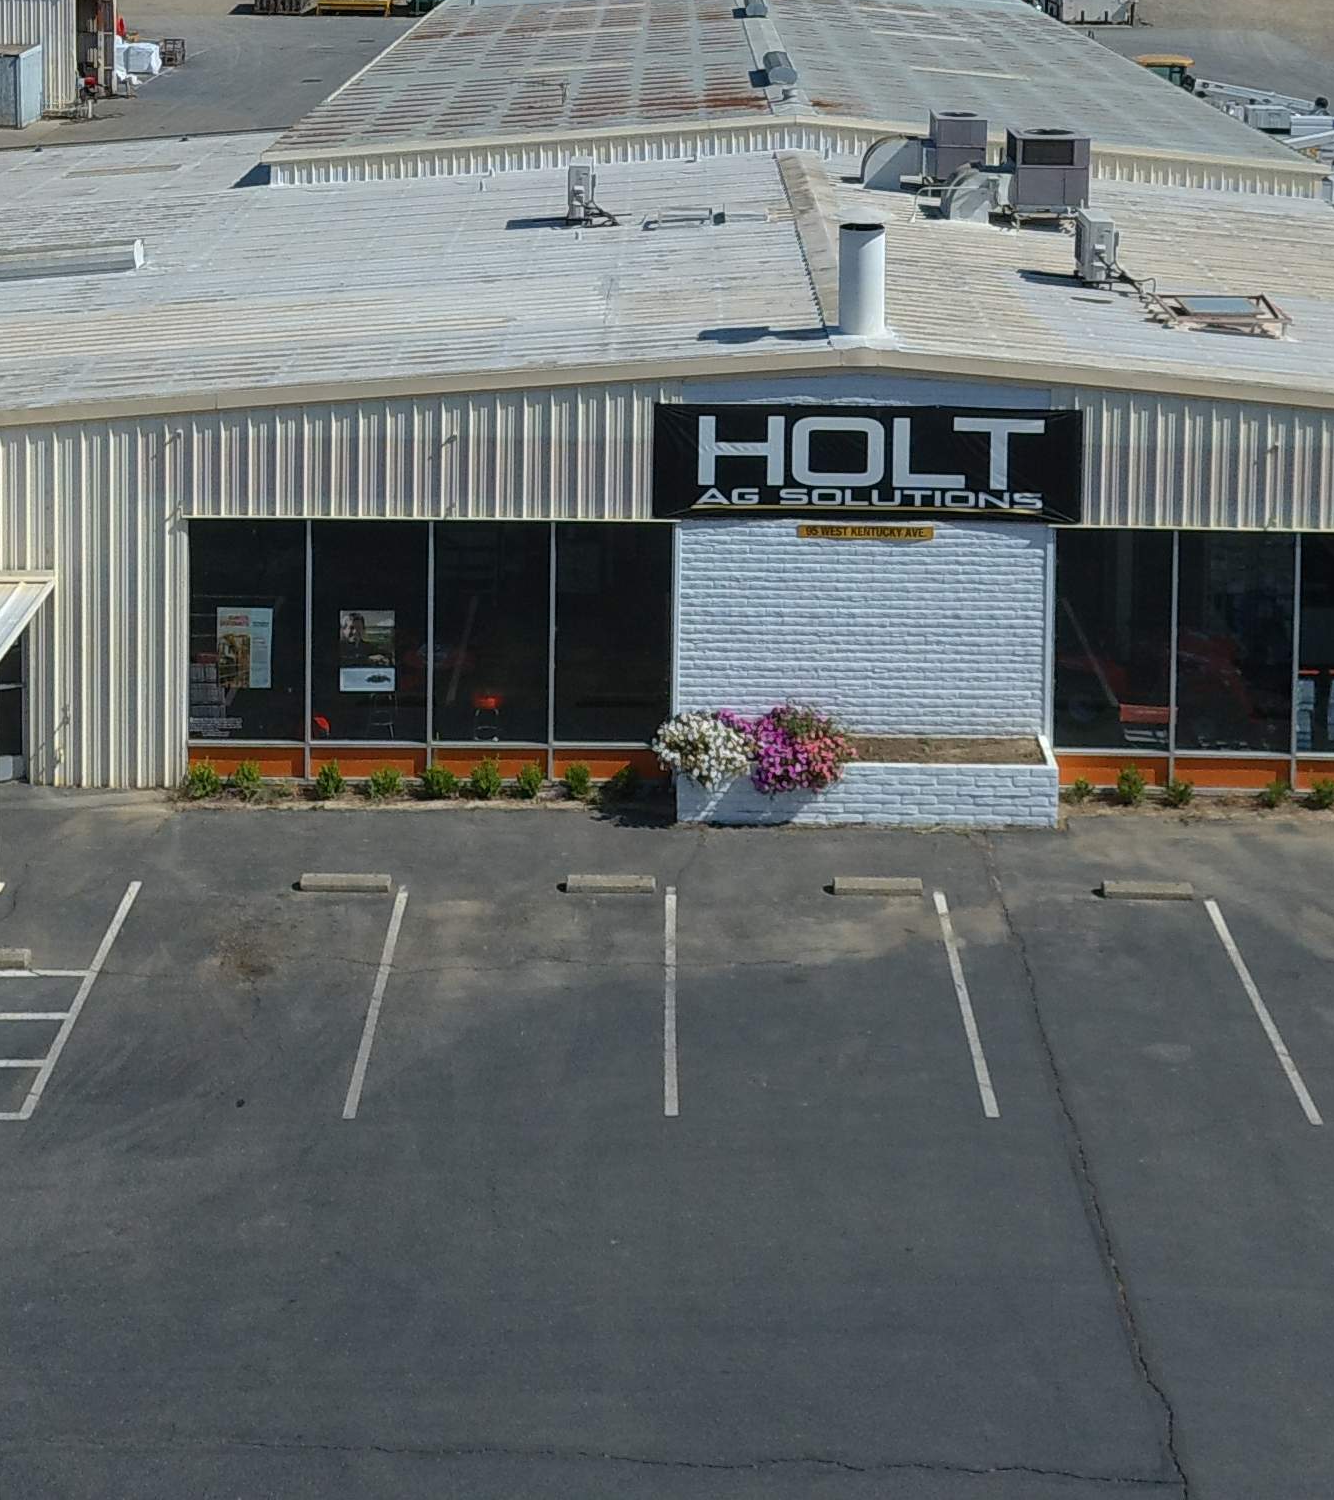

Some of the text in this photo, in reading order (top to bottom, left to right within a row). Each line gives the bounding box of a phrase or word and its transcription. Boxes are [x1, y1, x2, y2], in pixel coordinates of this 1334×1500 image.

[697, 415, 1046, 491] HOLT
[696, 488, 1044, 509] AG SOLUTIONS
[821, 526, 847, 537] WEST
[850, 526, 902, 538] KENTUCKY
